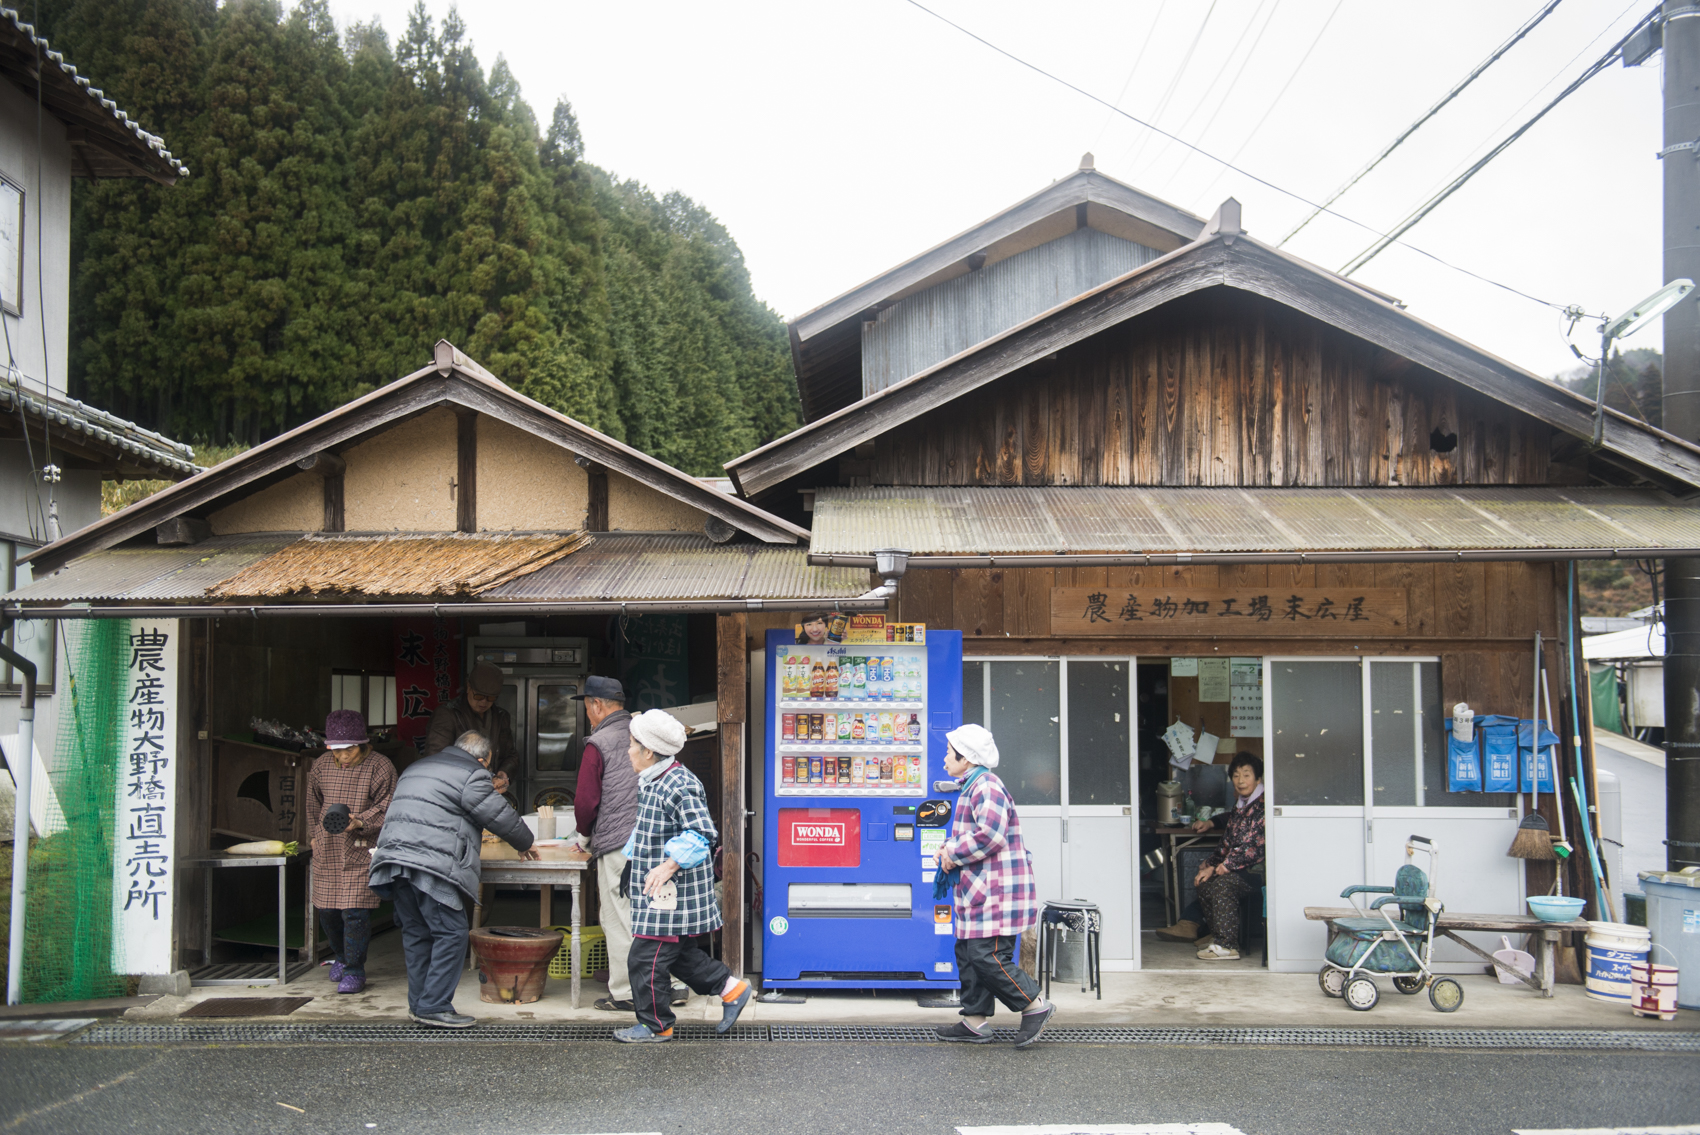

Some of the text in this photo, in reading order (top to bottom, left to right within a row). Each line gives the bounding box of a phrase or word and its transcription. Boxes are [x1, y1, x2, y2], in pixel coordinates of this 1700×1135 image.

[1082, 591, 1370, 624] 農産物加工場末広屋
[852, 616, 882, 624] WONDA
[827, 647, 847, 655] Asahi
[1249, 666, 1255, 674] 2
[124, 626, 169, 920] 農産物大野橋直売所
[278, 775, 296, 832] 百円均一
[796, 826, 840, 837] WONDA
[1606, 950, 1639, 960] ダフニー
[1611, 963, 1632, 972] スーパー
